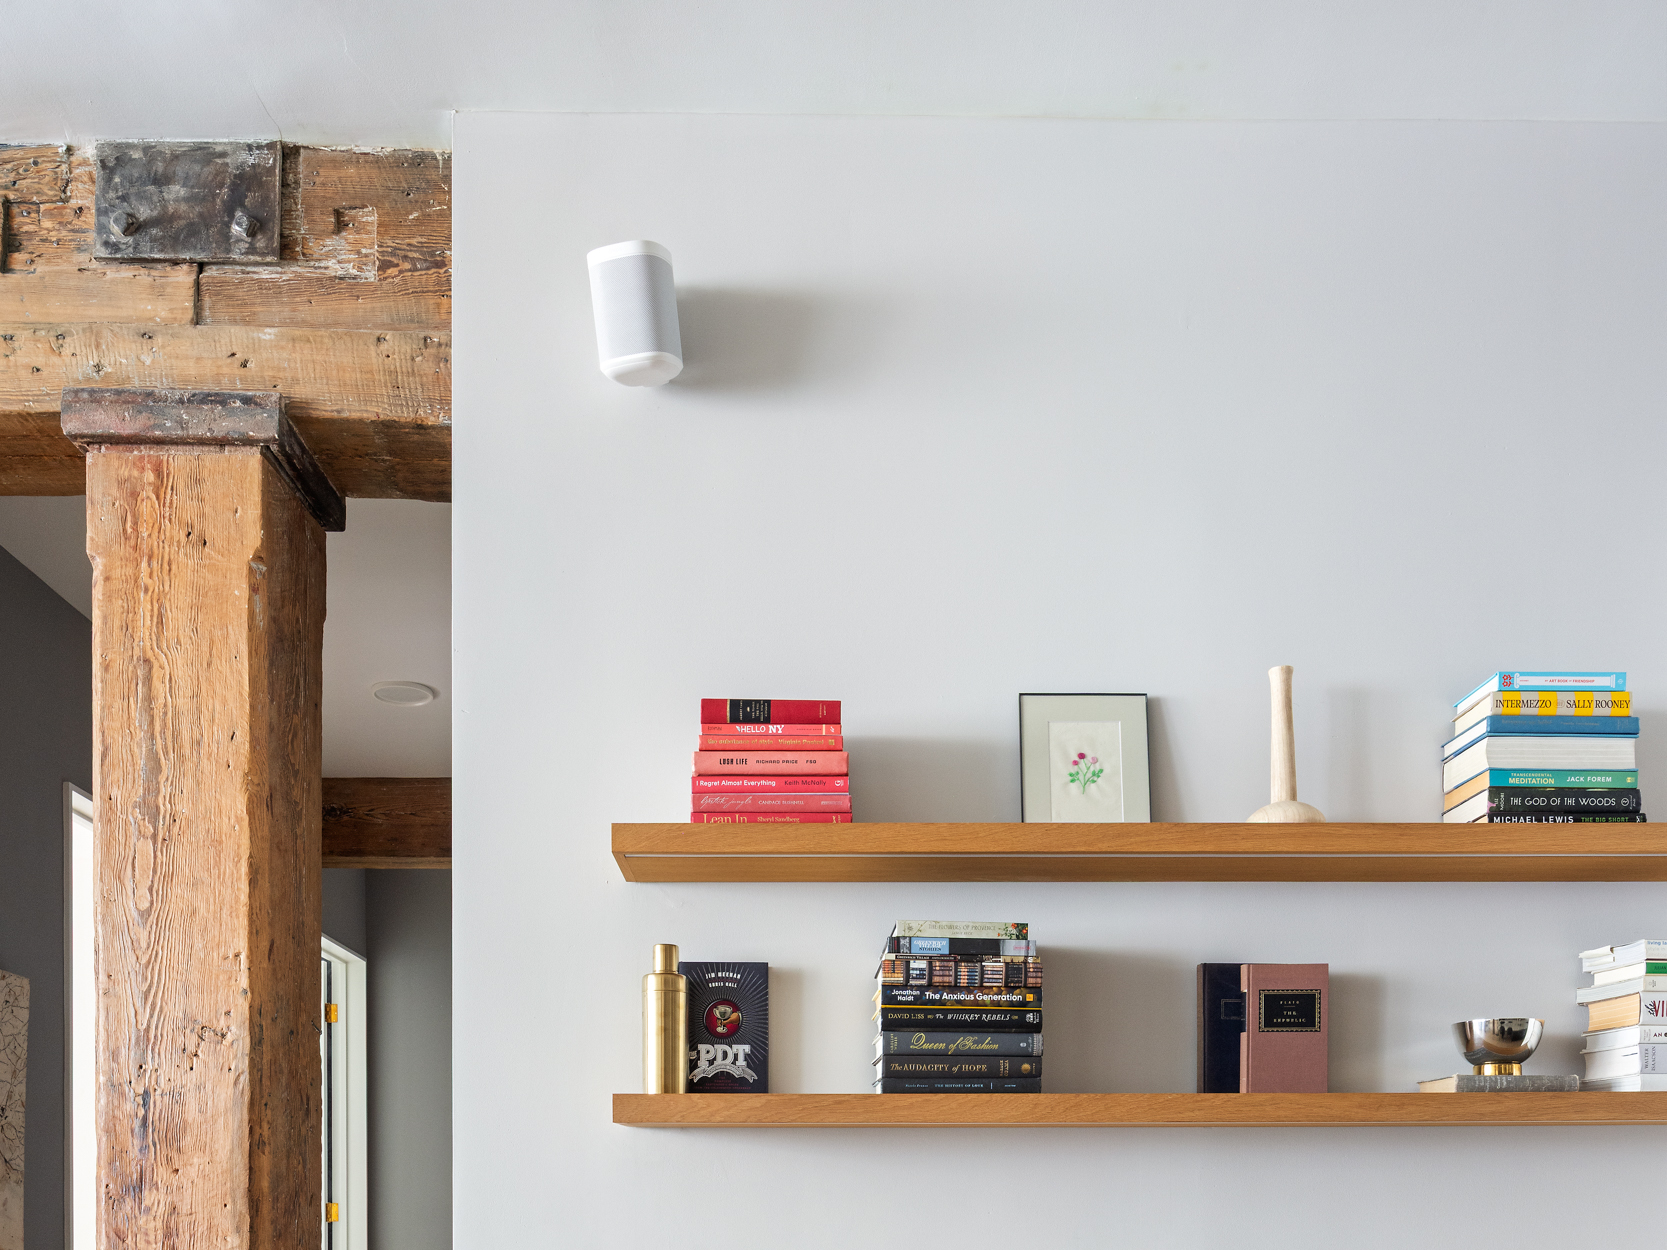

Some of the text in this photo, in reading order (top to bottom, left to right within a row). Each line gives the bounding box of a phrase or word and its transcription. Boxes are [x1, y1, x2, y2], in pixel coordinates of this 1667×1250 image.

[1495, 699, 1552, 708] INTERMEZZO
[1566, 699, 1594, 708] SALLY
[1595, 699, 1631, 709] ROONEY
[740, 725, 785, 733] HELLO NY
[1510, 797, 1616, 806] THE GOD OF THE WOODS
[703, 814, 748, 823] Lean In
[924, 991, 1023, 1001] The Anxious Generation
[1645, 1000, 1655, 1017] the
[947, 1013, 980, 1022] WHISKEY
[981, 1013, 1010, 1022] REBELS
[910, 1032, 999, 1055] Queen of Fashion
[697, 1044, 751, 1067] PDT
[890, 1063, 987, 1073] The AUDACITY of HOPE
